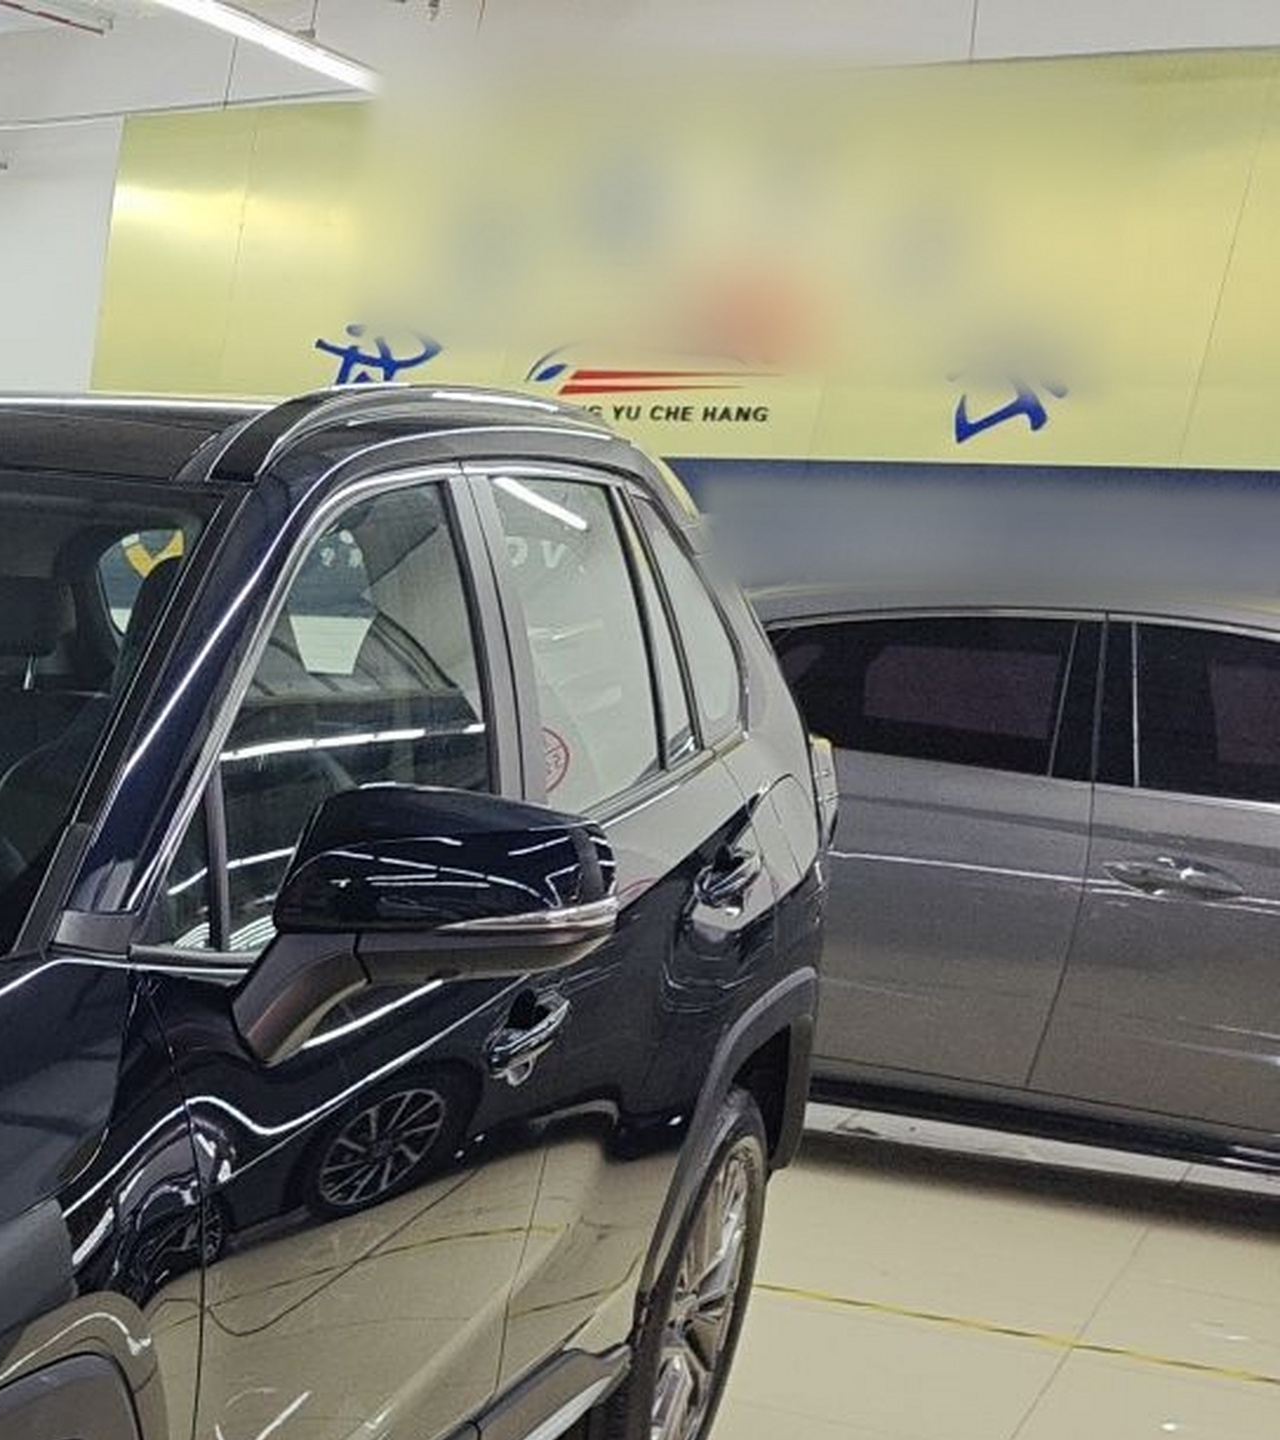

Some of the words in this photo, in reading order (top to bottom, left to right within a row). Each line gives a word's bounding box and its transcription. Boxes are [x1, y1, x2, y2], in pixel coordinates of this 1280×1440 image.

[612, 404, 642, 421] YU
[649, 404, 695, 422] CHE
[701, 405, 770, 422] HANG
